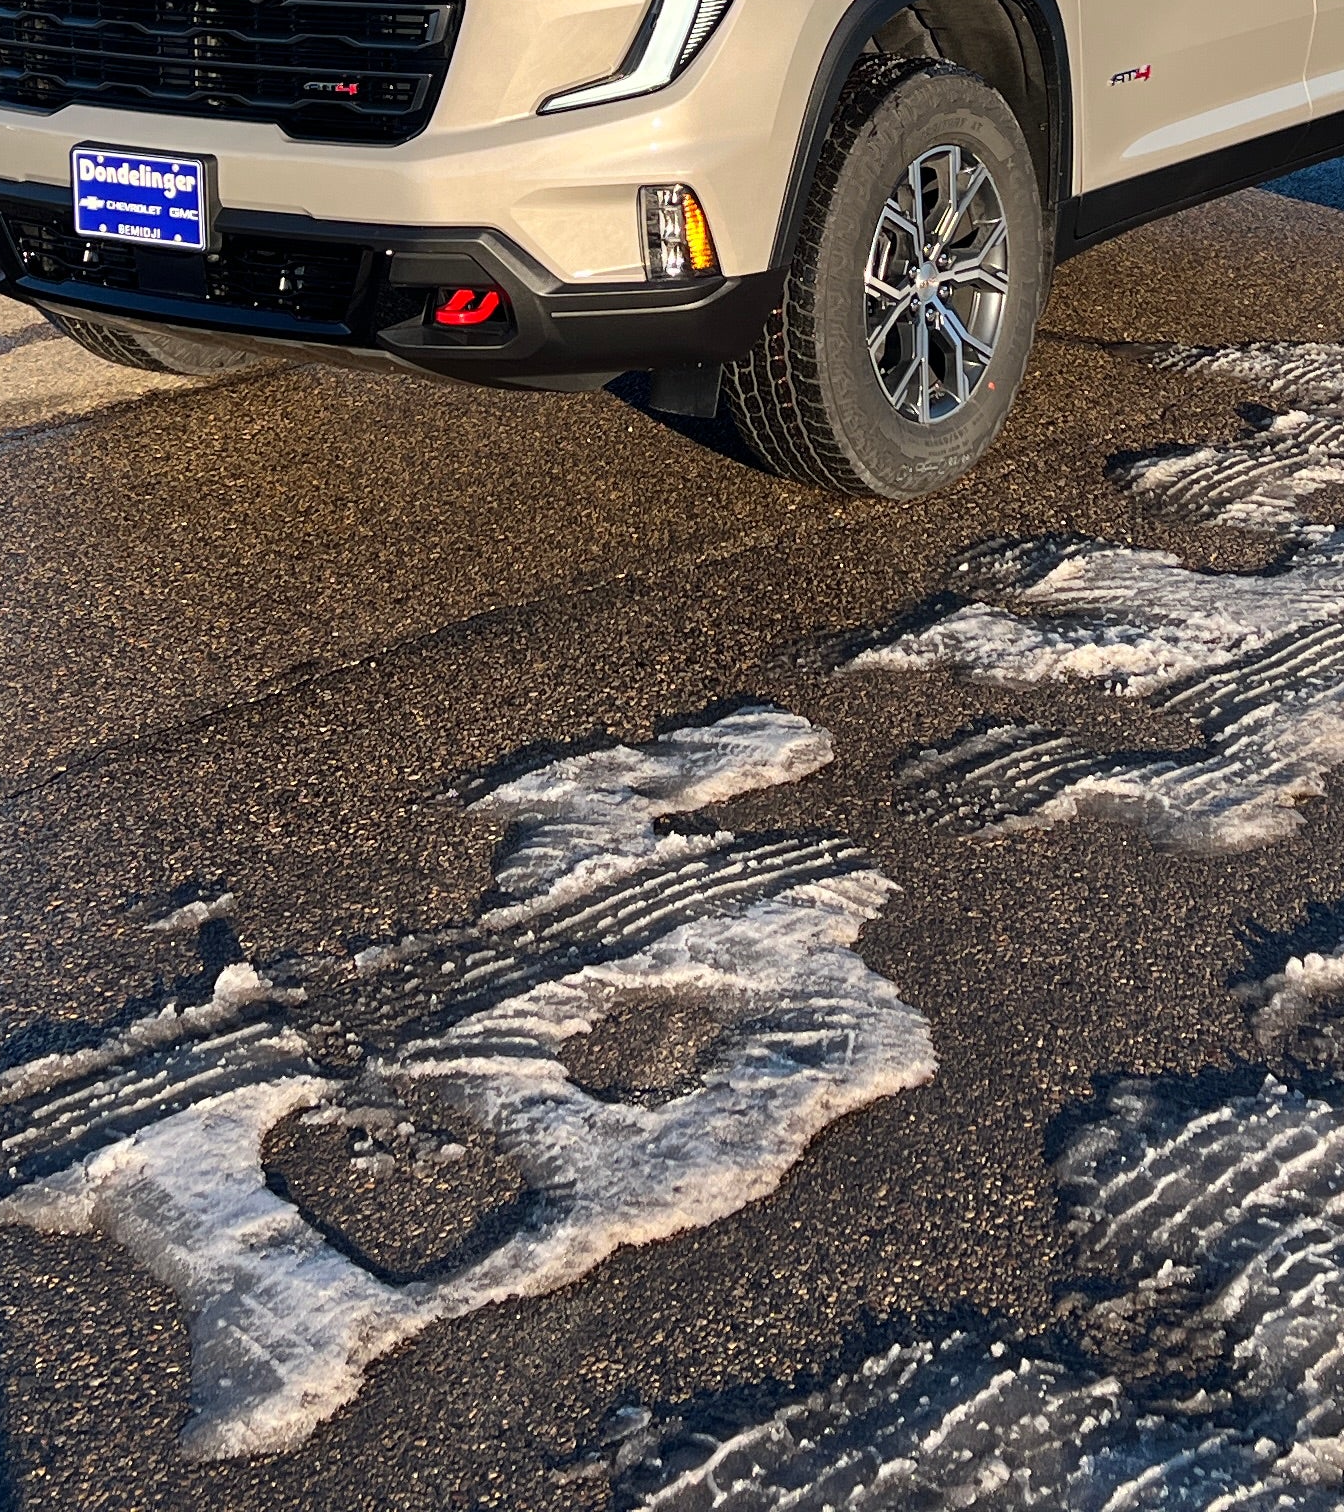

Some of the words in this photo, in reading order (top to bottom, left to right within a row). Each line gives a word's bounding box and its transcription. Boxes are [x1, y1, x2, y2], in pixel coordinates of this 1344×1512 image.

[1110, 65, 1151, 86] AT4
[303, 81, 359, 95] AT4
[79, 157, 197, 199] Dondelinger
[106, 200, 162, 215] CHEVROLET
[169, 207, 199, 221] GMC
[118, 223, 161, 239] BEMIDJI
